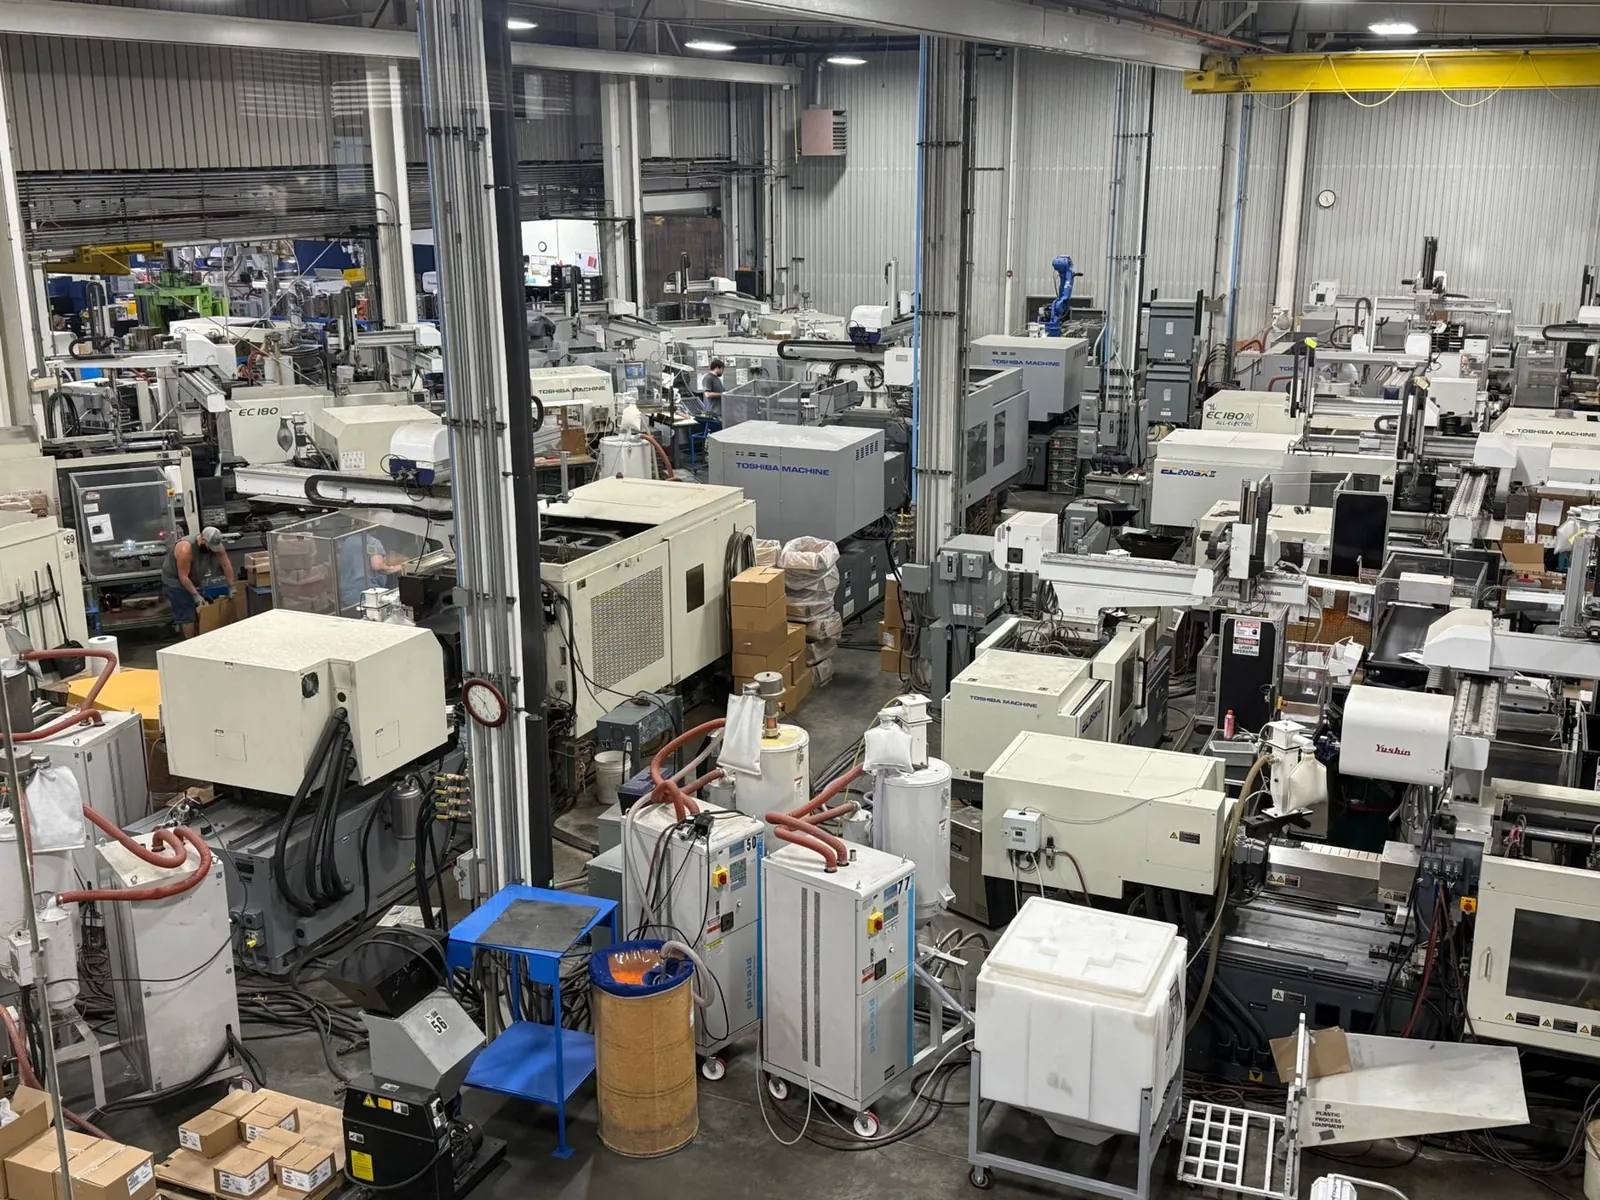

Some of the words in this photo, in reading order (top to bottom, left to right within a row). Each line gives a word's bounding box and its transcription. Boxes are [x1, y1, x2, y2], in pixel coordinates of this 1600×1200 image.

[1556, 430, 1597, 438] MACHINE
[736, 462, 780, 472] TOSHIBA
[781, 465, 830, 476] MACHINE
[969, 695, 1001, 704] TOSHIBA
[1002, 699, 1038, 709] MACHINE
[1376, 744, 1411, 756] Yushin
[746, 836, 757, 852] 50
[897, 875, 911, 895] 77
[745, 956, 754, 1010] plas-aid
[430, 1016, 448, 1034] 56
[1314, 1116, 1342, 1124] PROCESS
[1315, 1110, 1341, 1118] PLASTIC
[1311, 1121, 1345, 1130] EQUIPMENT
